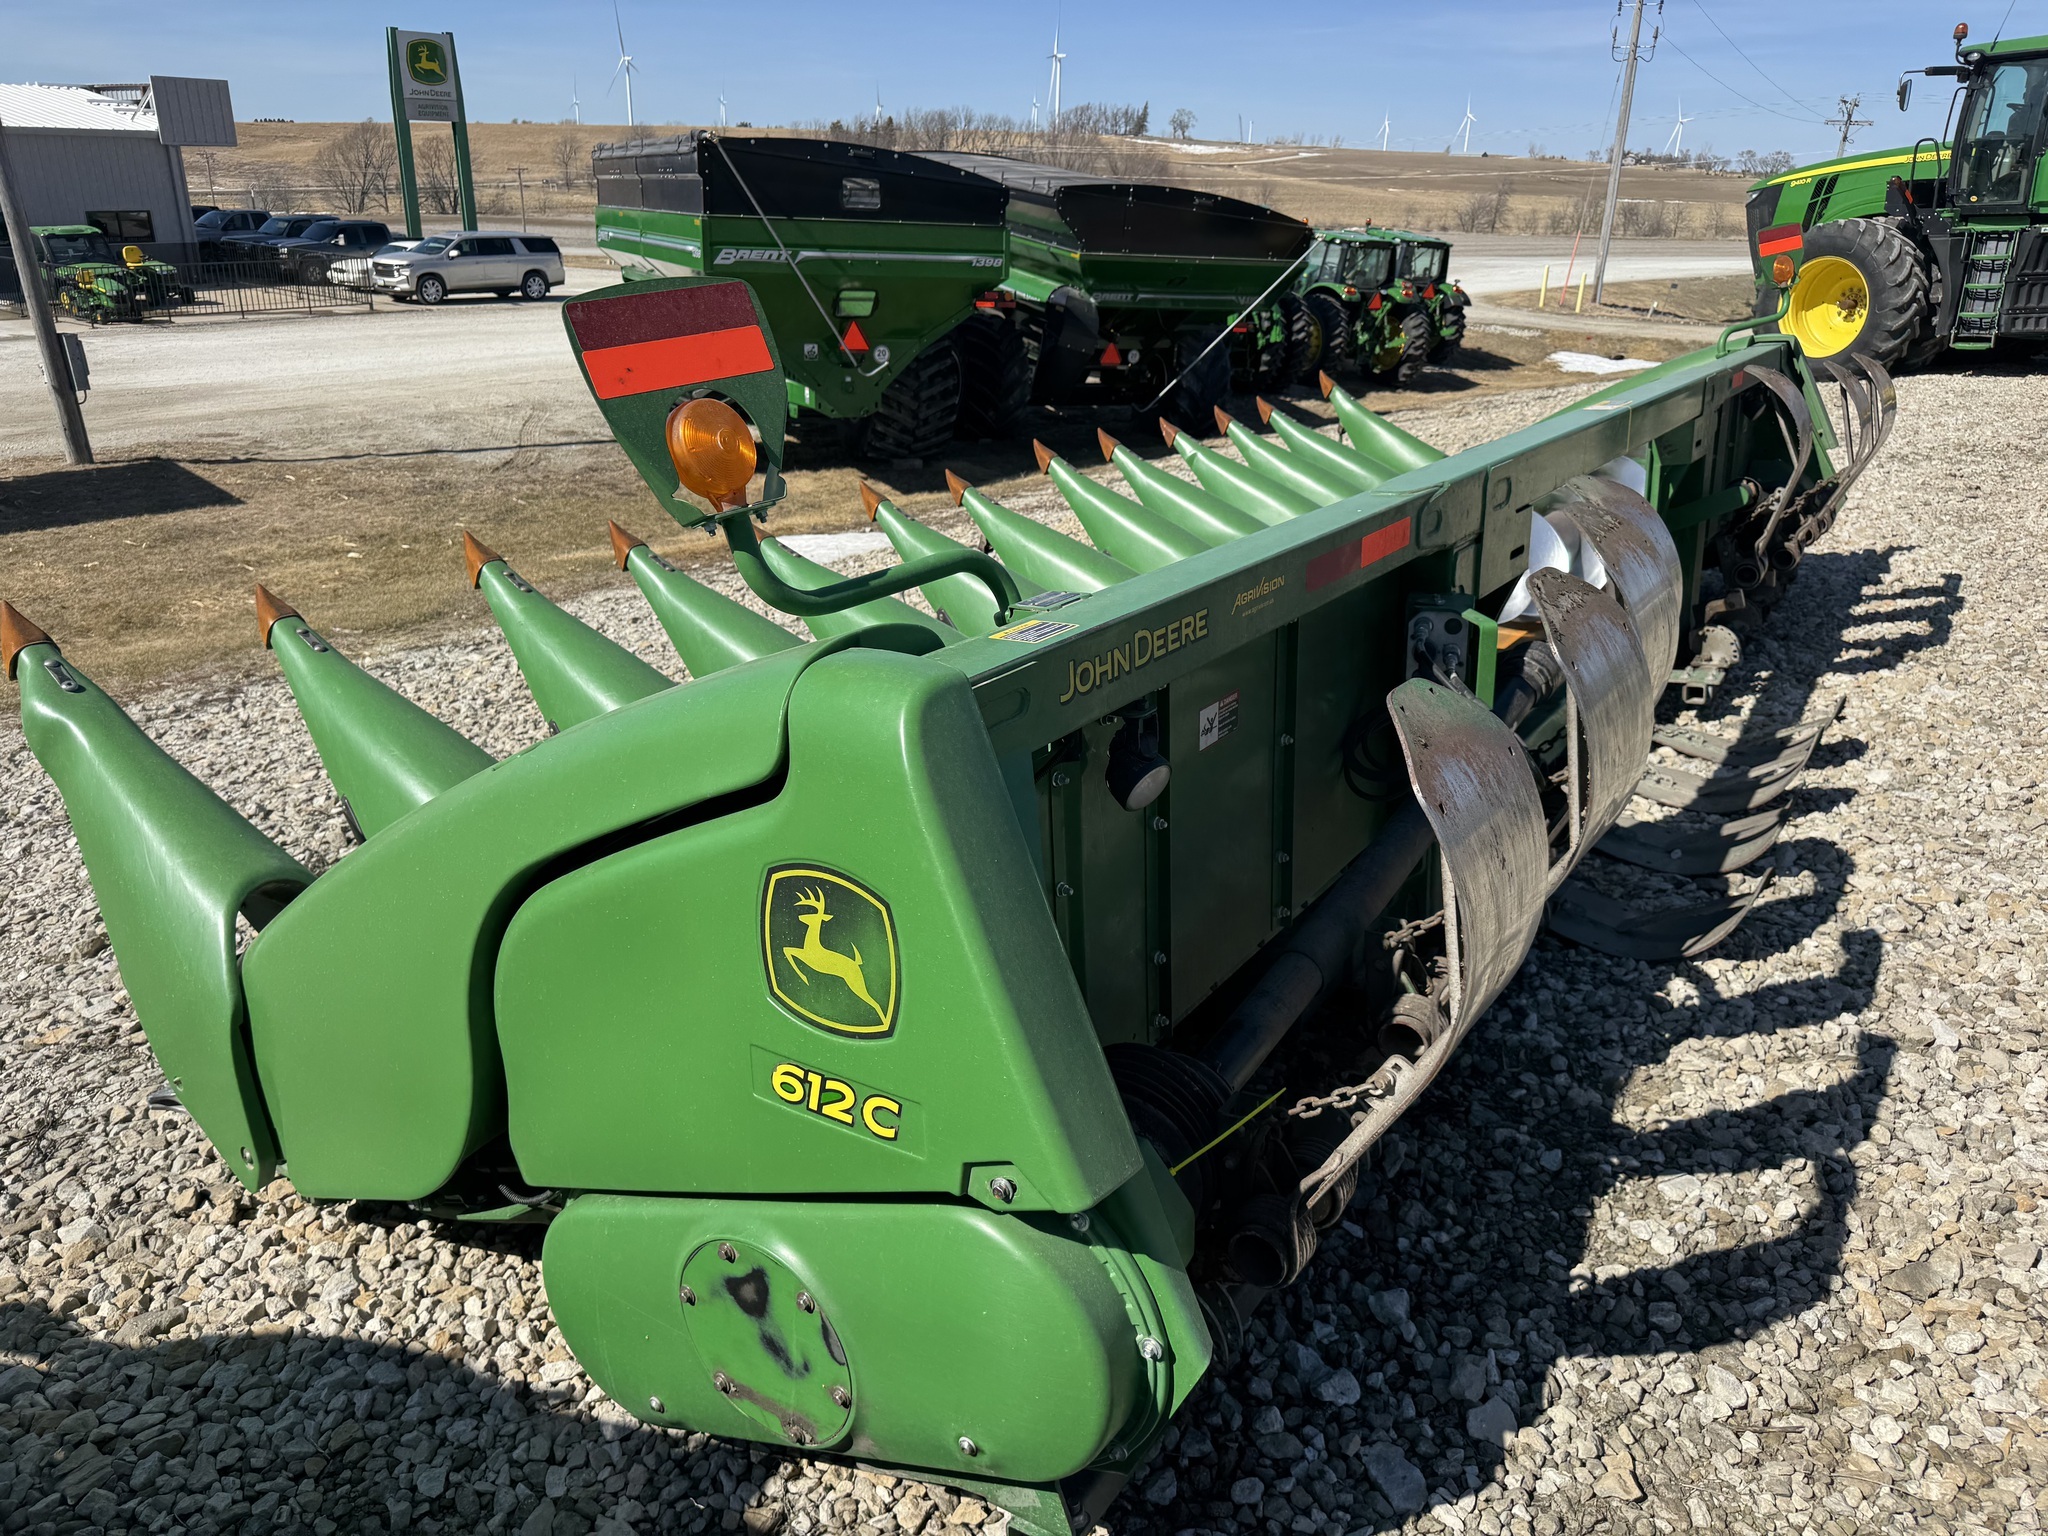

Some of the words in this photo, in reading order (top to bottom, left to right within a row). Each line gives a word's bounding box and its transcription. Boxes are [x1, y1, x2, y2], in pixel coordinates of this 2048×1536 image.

[409, 88, 430, 97] JOHN
[713, 248, 792, 265] BRENT
[972, 258, 1003, 267] 1398
[876, 349, 887, 358] 20
[1060, 642, 1131, 704] JOHN
[1134, 607, 1210, 669] DEERE
